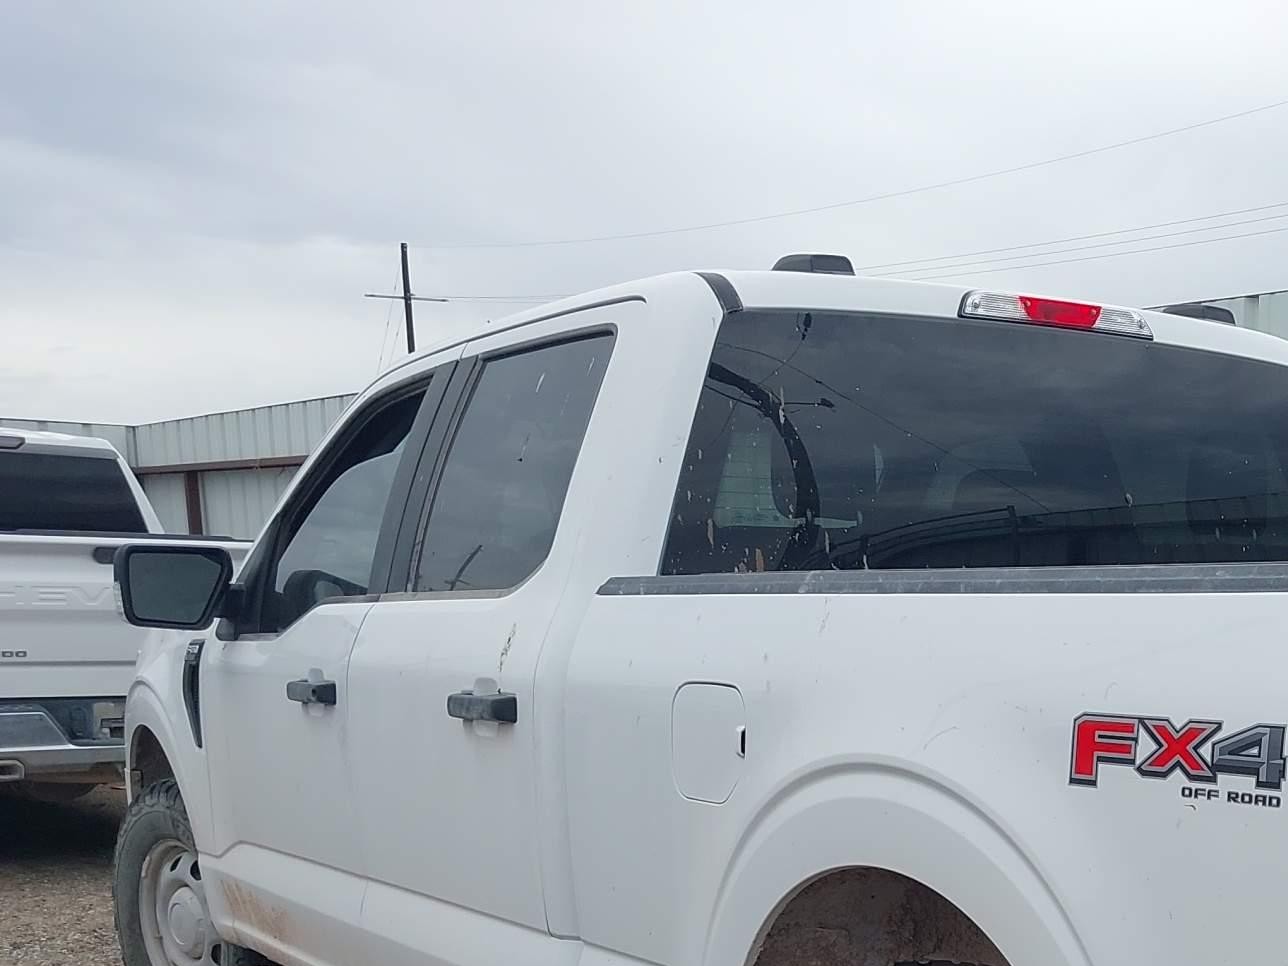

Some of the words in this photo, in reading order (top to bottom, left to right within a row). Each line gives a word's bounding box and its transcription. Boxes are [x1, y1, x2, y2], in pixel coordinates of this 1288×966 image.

[1069, 711, 1288, 790] FX4
[1181, 786, 1219, 801] OFF
[1226, 790, 1281, 808] ROAD
